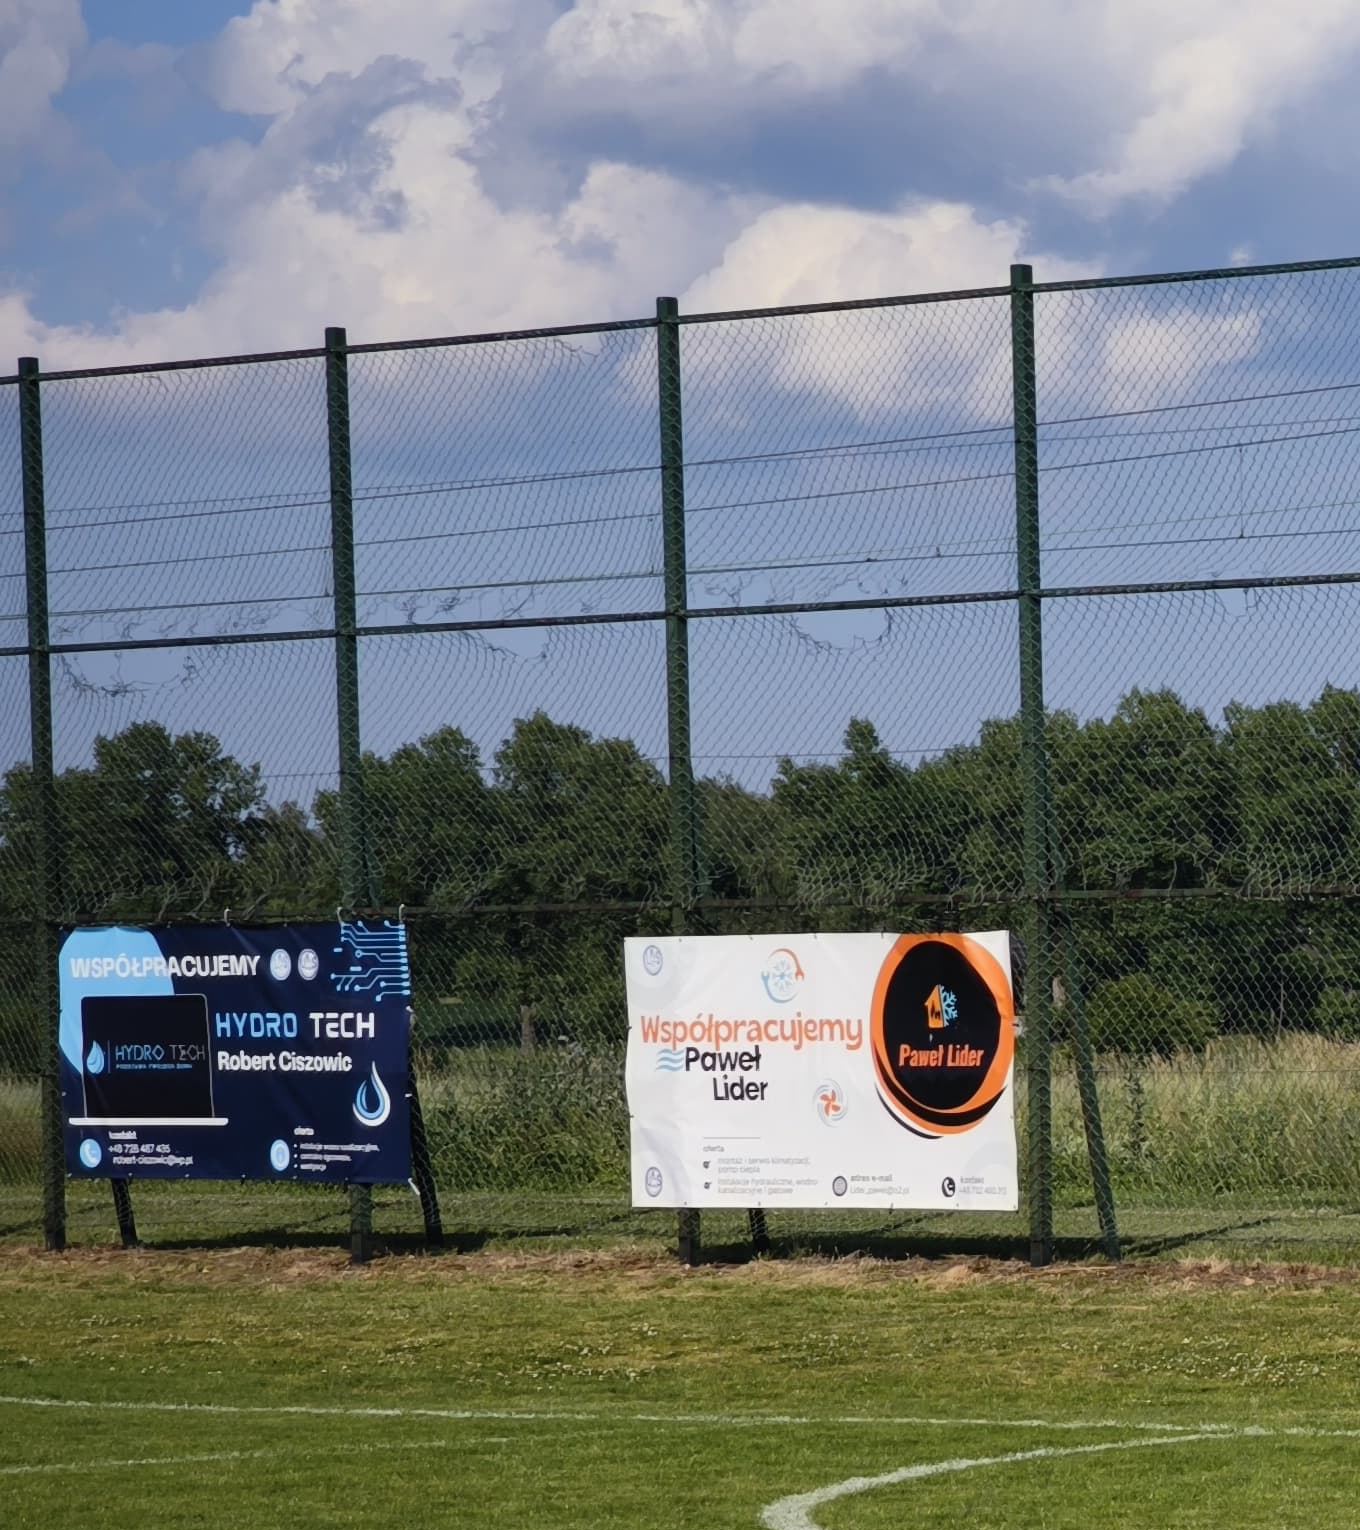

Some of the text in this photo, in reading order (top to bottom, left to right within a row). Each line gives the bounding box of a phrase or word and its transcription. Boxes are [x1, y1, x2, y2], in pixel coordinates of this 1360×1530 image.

[70, 954, 260, 978] WSPÓŁPRACUJEMY
[216, 1012, 375, 1038] HYDRO TECH
[640, 1013, 863, 1050] Współpracujemy
[115, 1044, 206, 1061] HYDRO TECH
[217, 1051, 353, 1072] Robert Ciszowic
[683, 1044, 762, 1072] Paweł
[899, 1041, 984, 1067] Paweł Lider
[713, 1075, 768, 1101] Lider
